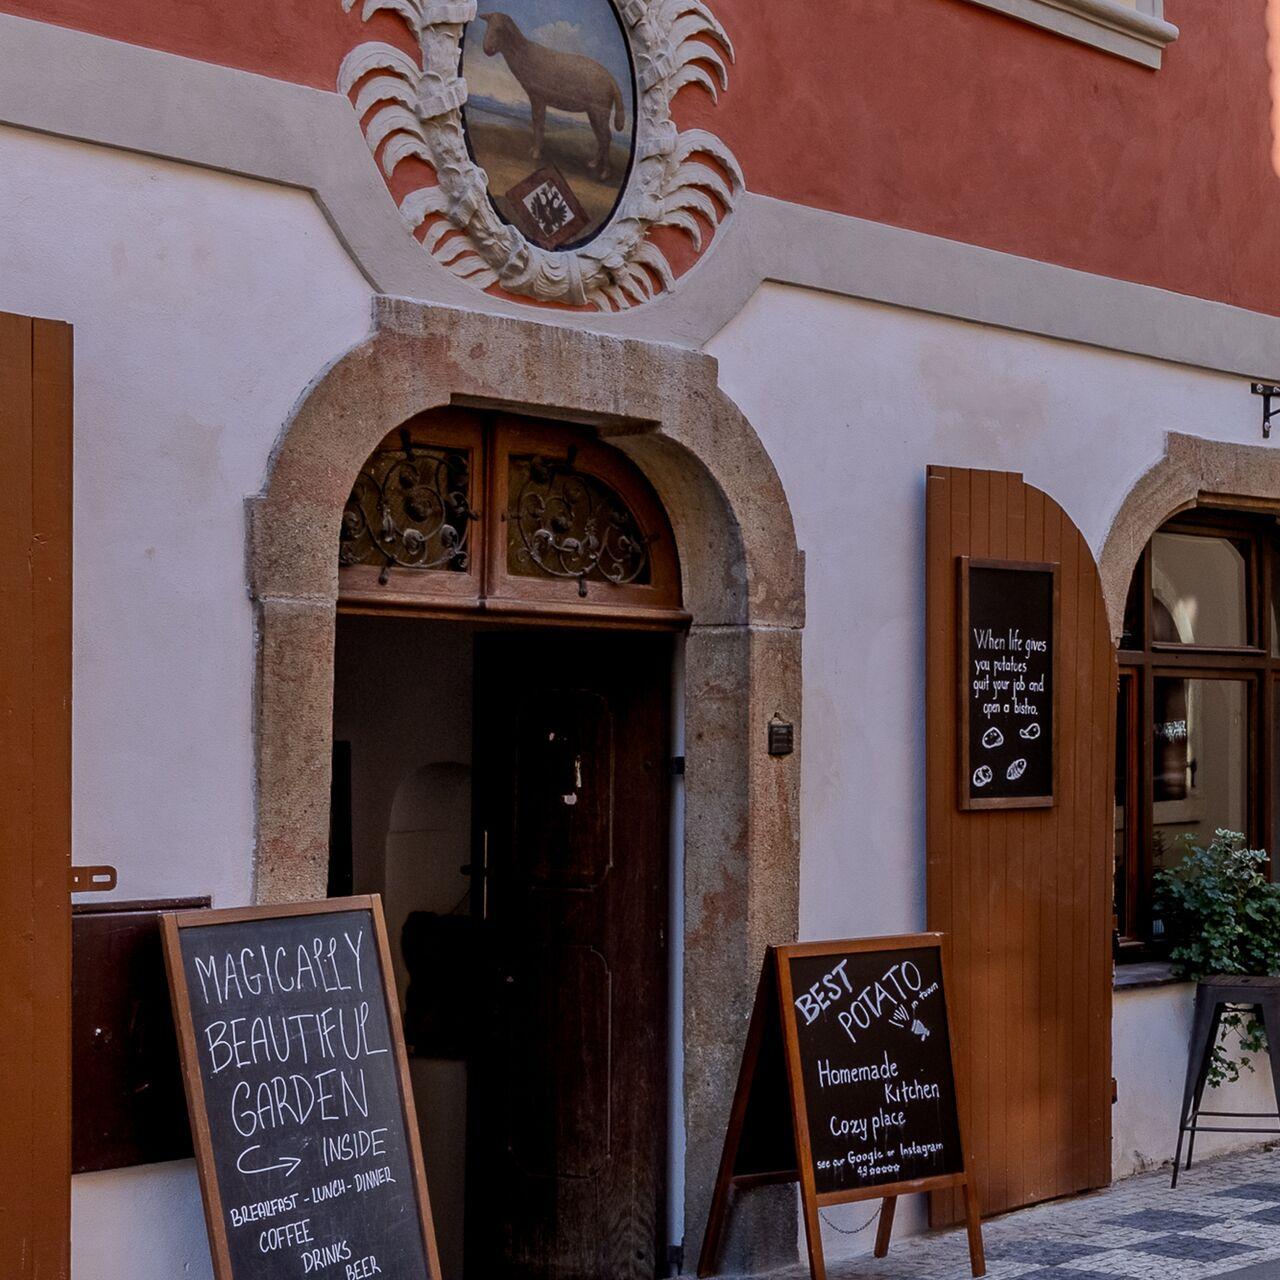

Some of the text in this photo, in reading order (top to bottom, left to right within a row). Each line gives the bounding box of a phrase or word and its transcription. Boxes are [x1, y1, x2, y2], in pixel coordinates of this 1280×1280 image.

[974, 627, 1047, 659] When life gives
[974, 655, 1028, 677] you potatoes
[973, 673, 1044, 700] quit your job and
[983, 703, 1000, 719] open
[1003, 704, 1010, 713] a
[194, 926, 364, 1004] MAGICALLY
[794, 958, 854, 1025] BEST
[837, 960, 922, 1043] POTATO
[204, 1001, 389, 1074] BEAUTIFUL
[817, 1051, 899, 1088] Homemade
[231, 1068, 369, 1137] GARDEN
[884, 1080, 940, 1104] Kitchen
[829, 1107, 906, 1141] Cozy place
[322, 1128, 389, 1167] INSIDE
[816, 1159, 831, 1169] see
[832, 1158, 846, 1167] our
[847, 1147, 884, 1166] Google
[900, 1141, 944, 1158] Instagram
[230, 1193, 299, 1228] BREAKFAST
[311, 1179, 346, 1204] LUNCH
[353, 1166, 396, 1192] DINNER
[259, 1219, 315, 1254] COFFEE
[300, 1240, 352, 1274] DRINKS
[345, 1255, 382, 1280] BEER
